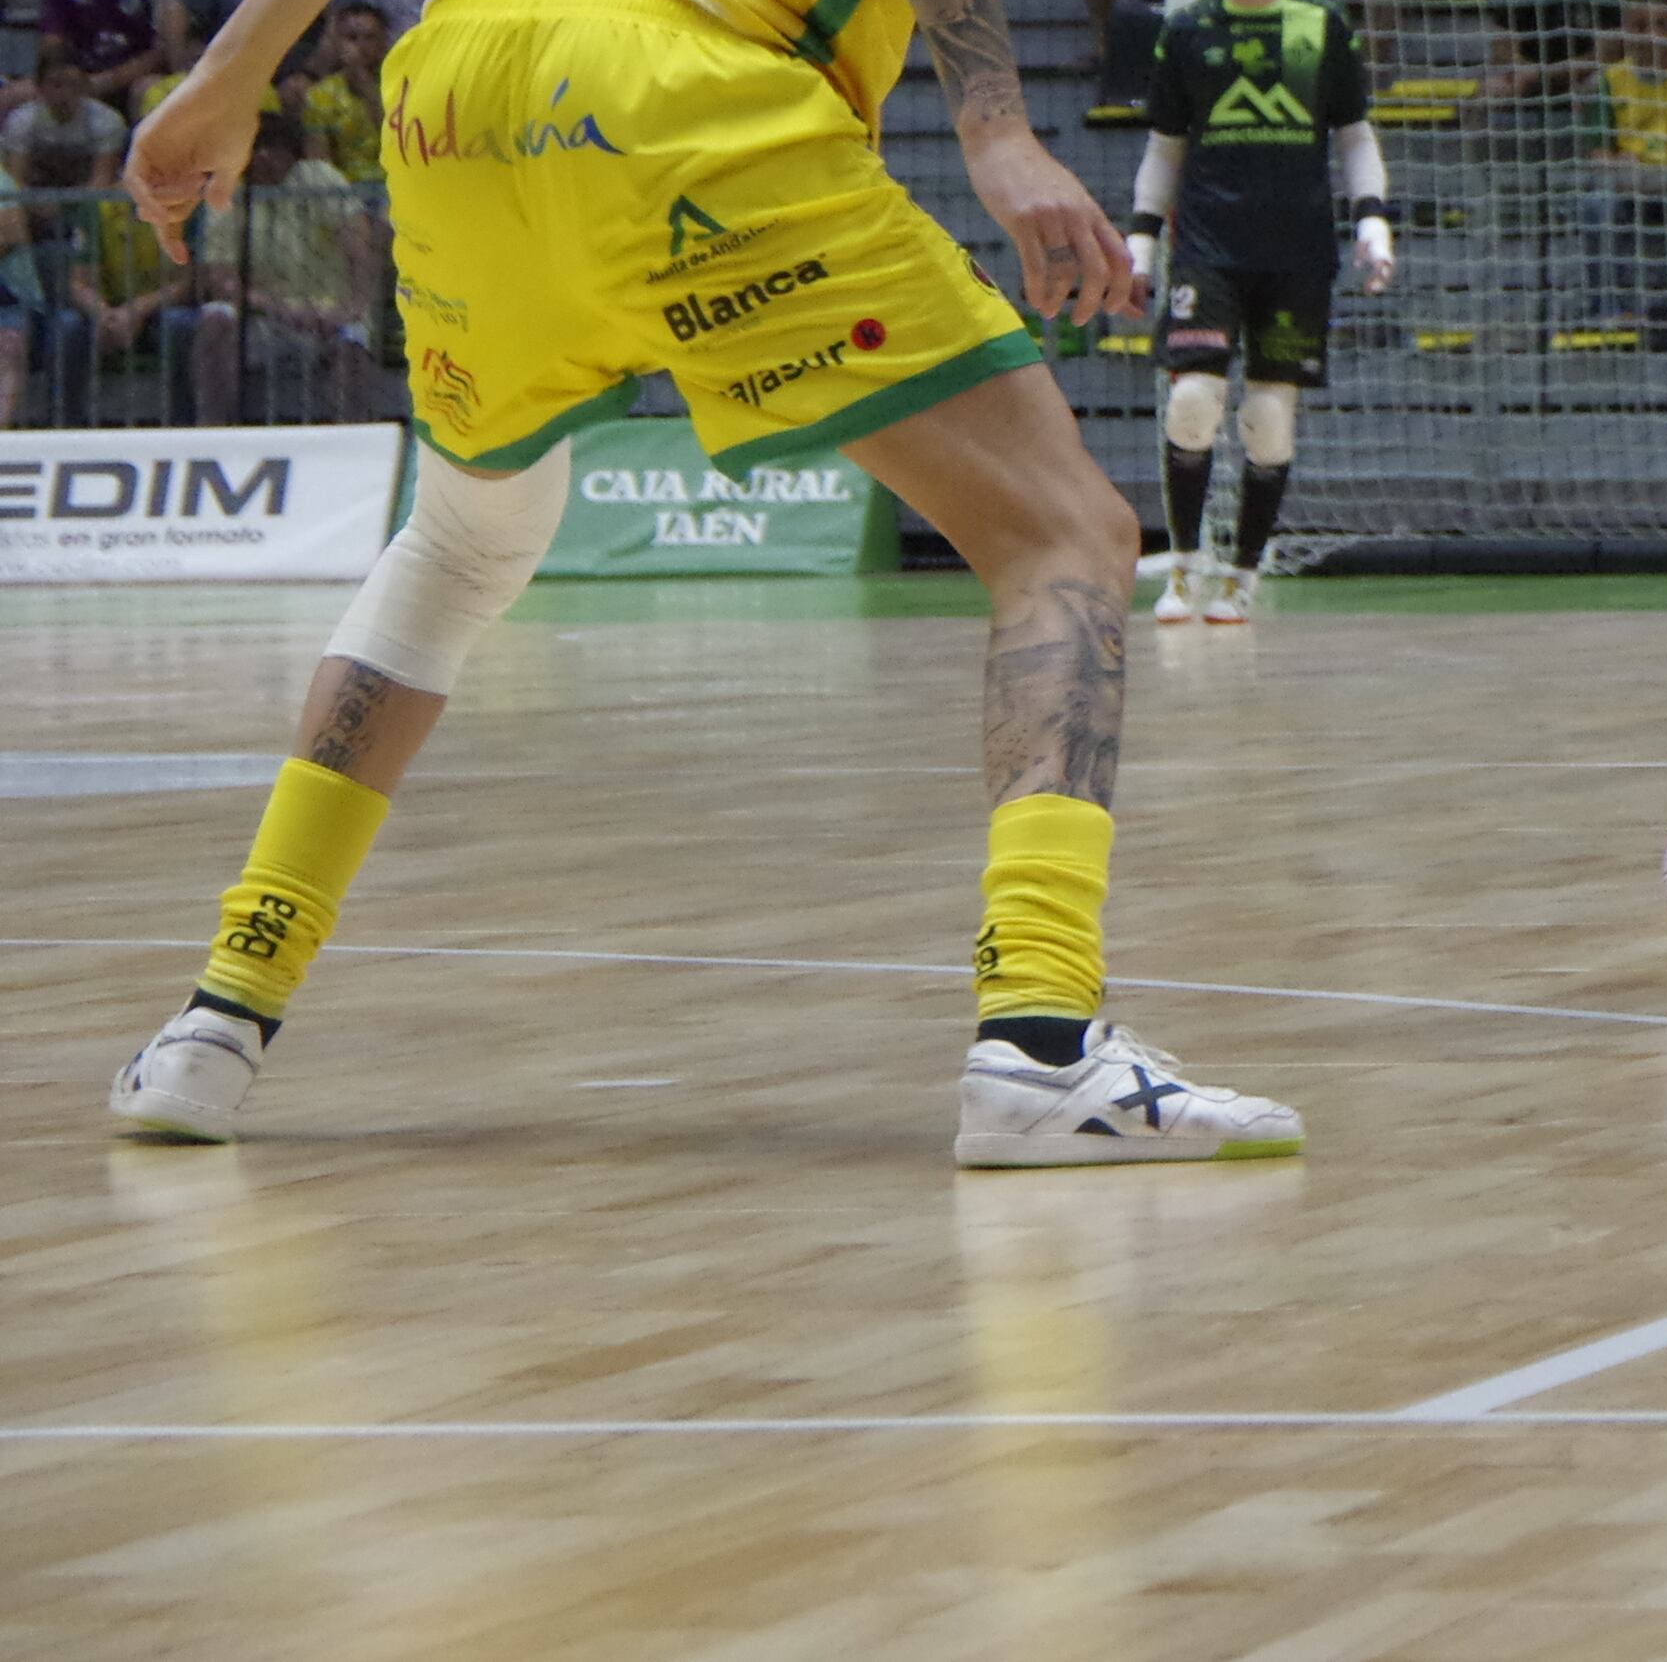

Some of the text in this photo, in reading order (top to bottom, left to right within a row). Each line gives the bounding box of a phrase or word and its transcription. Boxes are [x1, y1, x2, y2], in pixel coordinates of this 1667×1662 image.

[689, 249, 710, 267] de
[662, 258, 830, 343] Blanca
[721, 339, 848, 408] ajasur
[696, 467, 852, 504] RURAL
